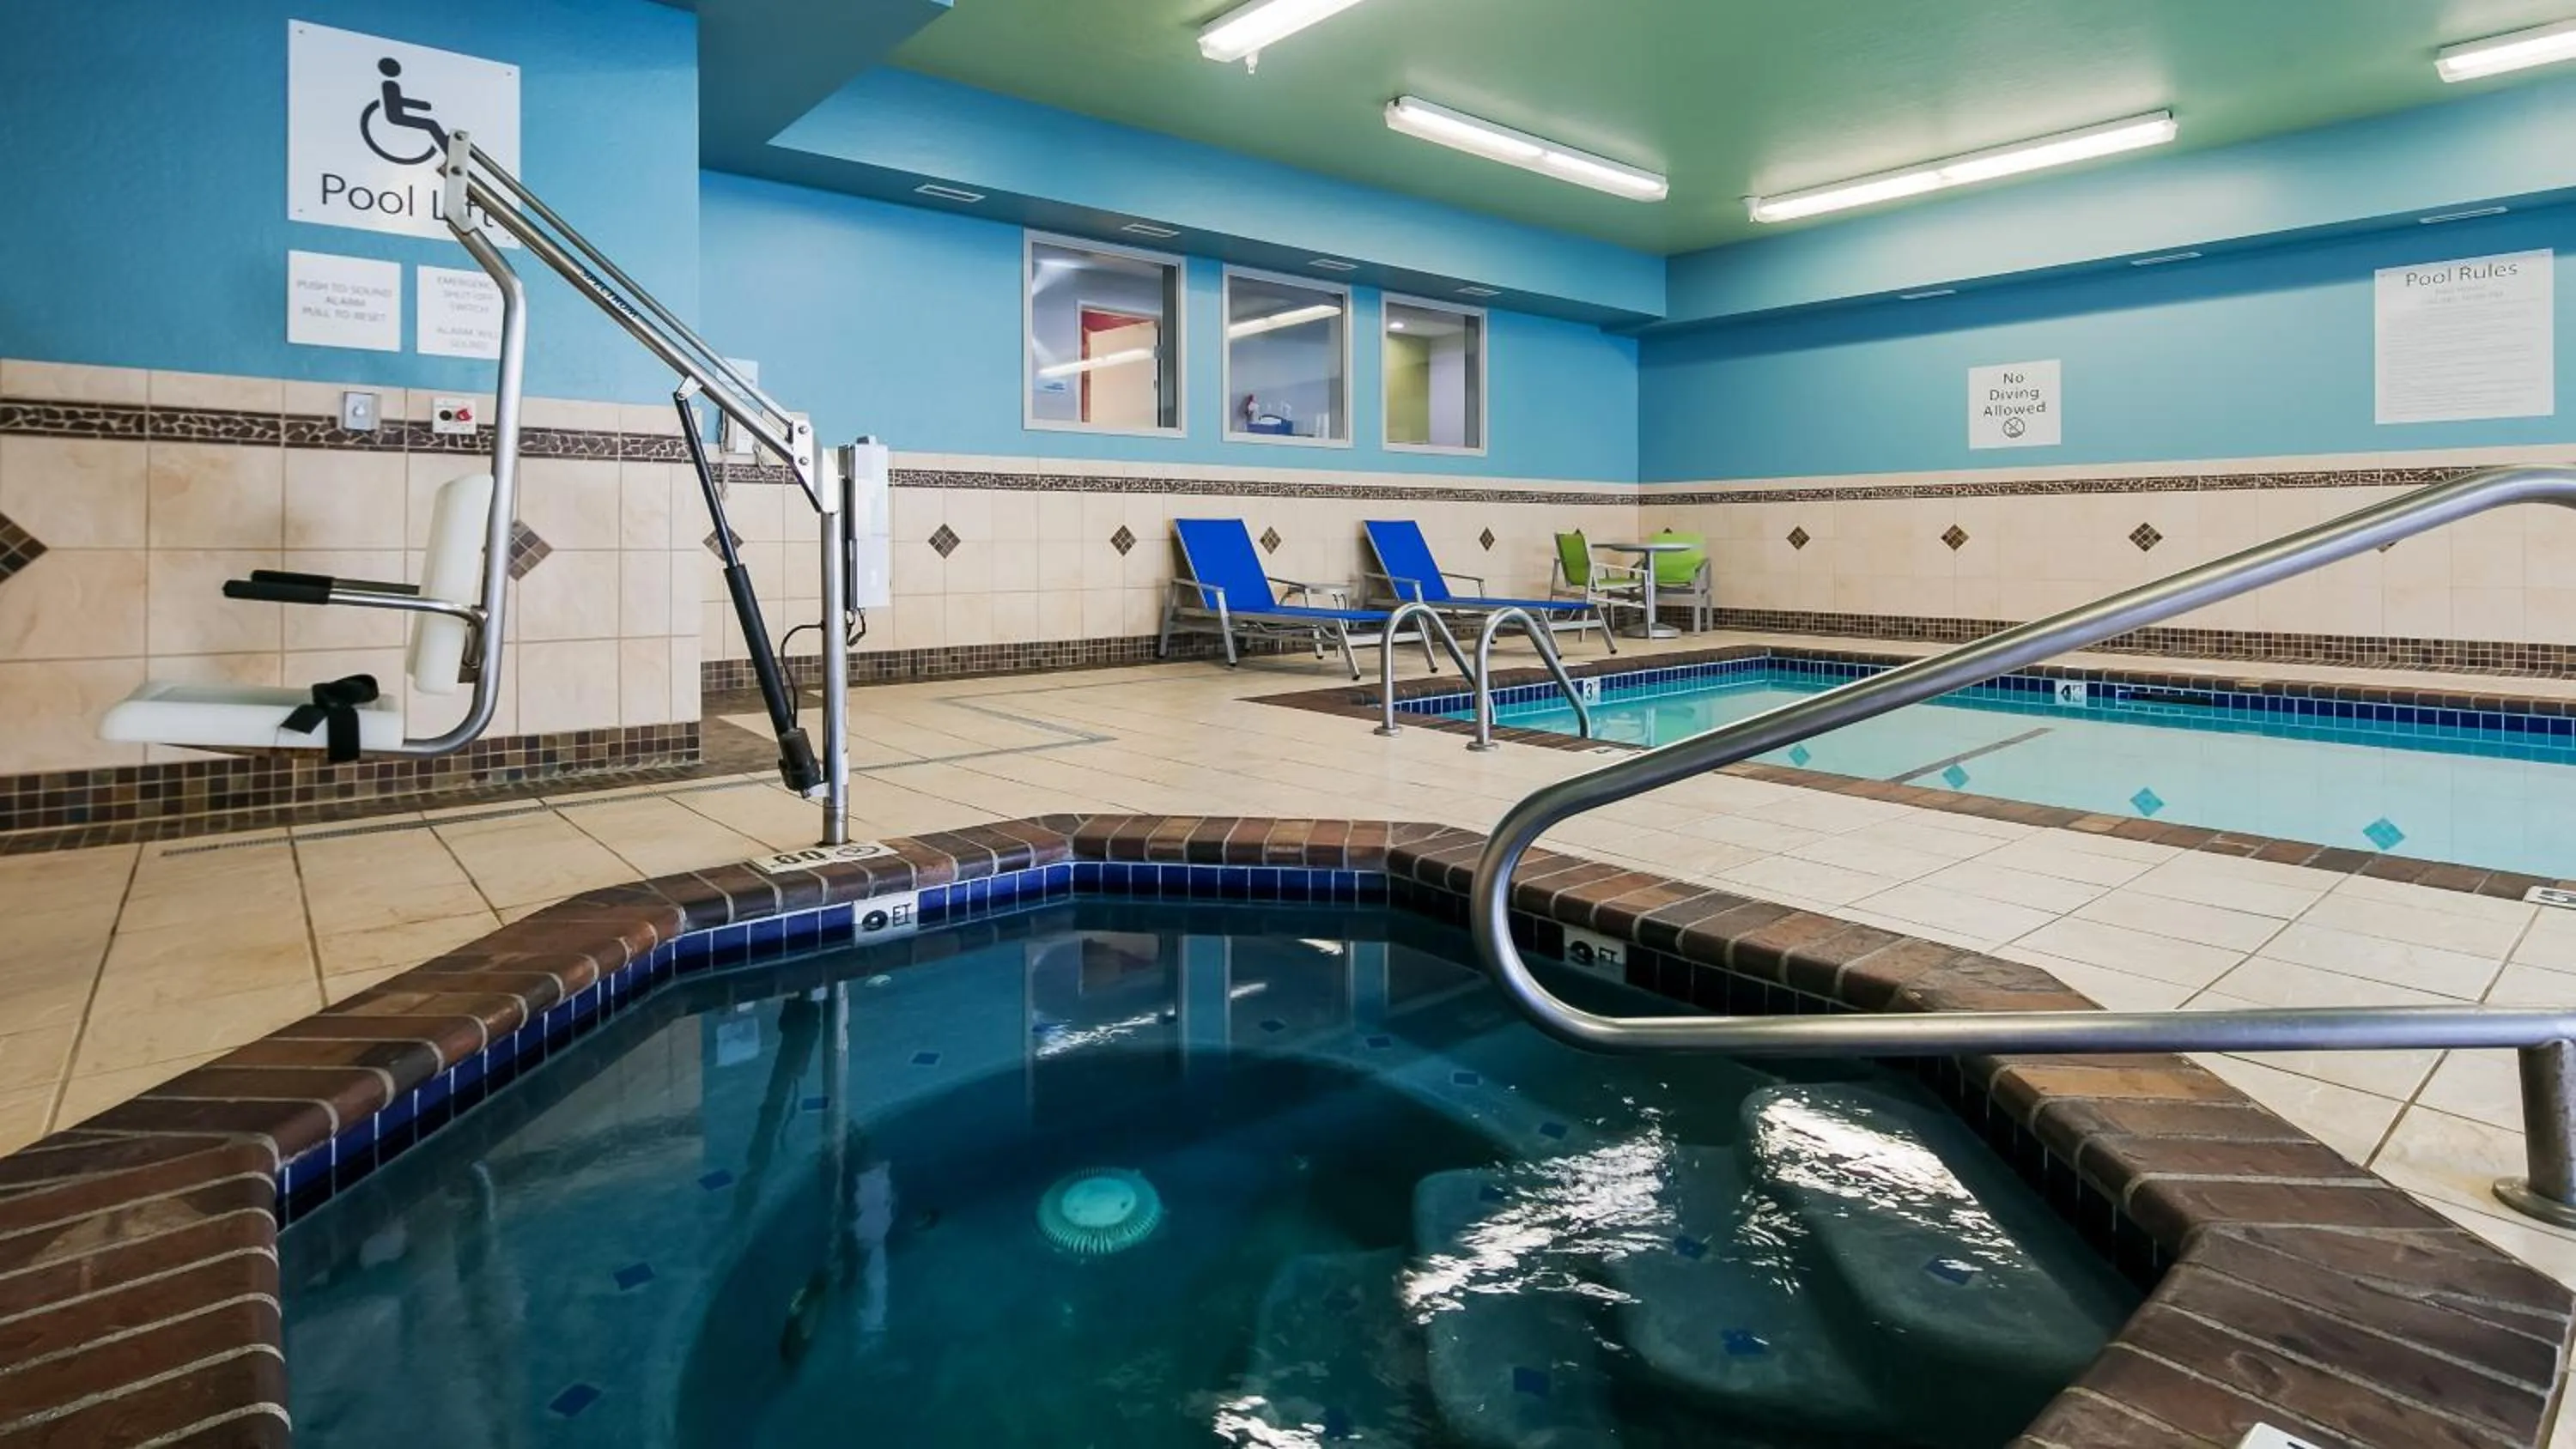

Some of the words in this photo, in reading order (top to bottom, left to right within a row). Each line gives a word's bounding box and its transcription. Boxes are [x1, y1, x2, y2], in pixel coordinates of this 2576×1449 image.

[321, 173, 413, 217] Pool
[2405, 267, 2451, 287] Pool
[2458, 263, 2518, 282] Rules
[2003, 372, 2025, 384] No
[1989, 387, 2040, 401] Diving
[1983, 401, 2046, 416] Allowed
